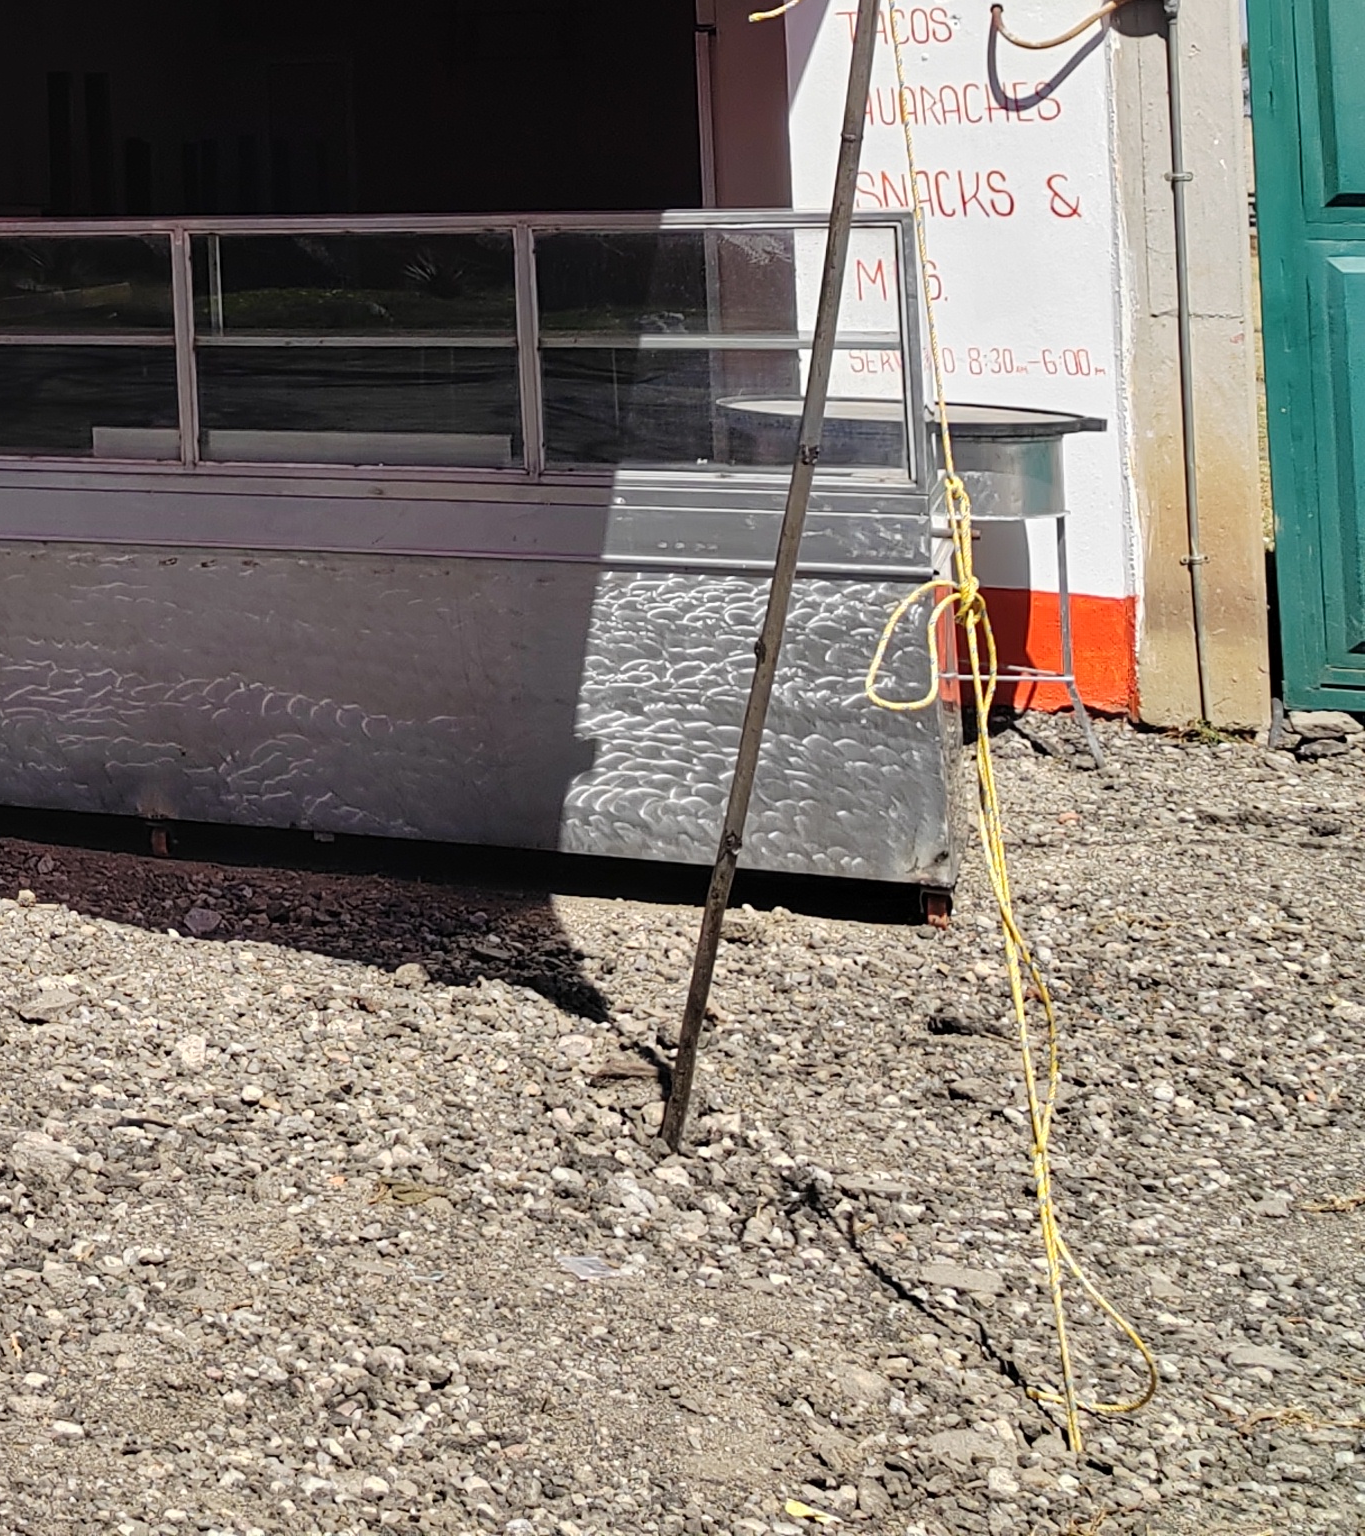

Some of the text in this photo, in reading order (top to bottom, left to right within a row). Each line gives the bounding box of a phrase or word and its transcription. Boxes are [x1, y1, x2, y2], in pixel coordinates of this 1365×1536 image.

[855, 169, 1082, 218] SNACKS &
[856, 258, 949, 302] MS.
